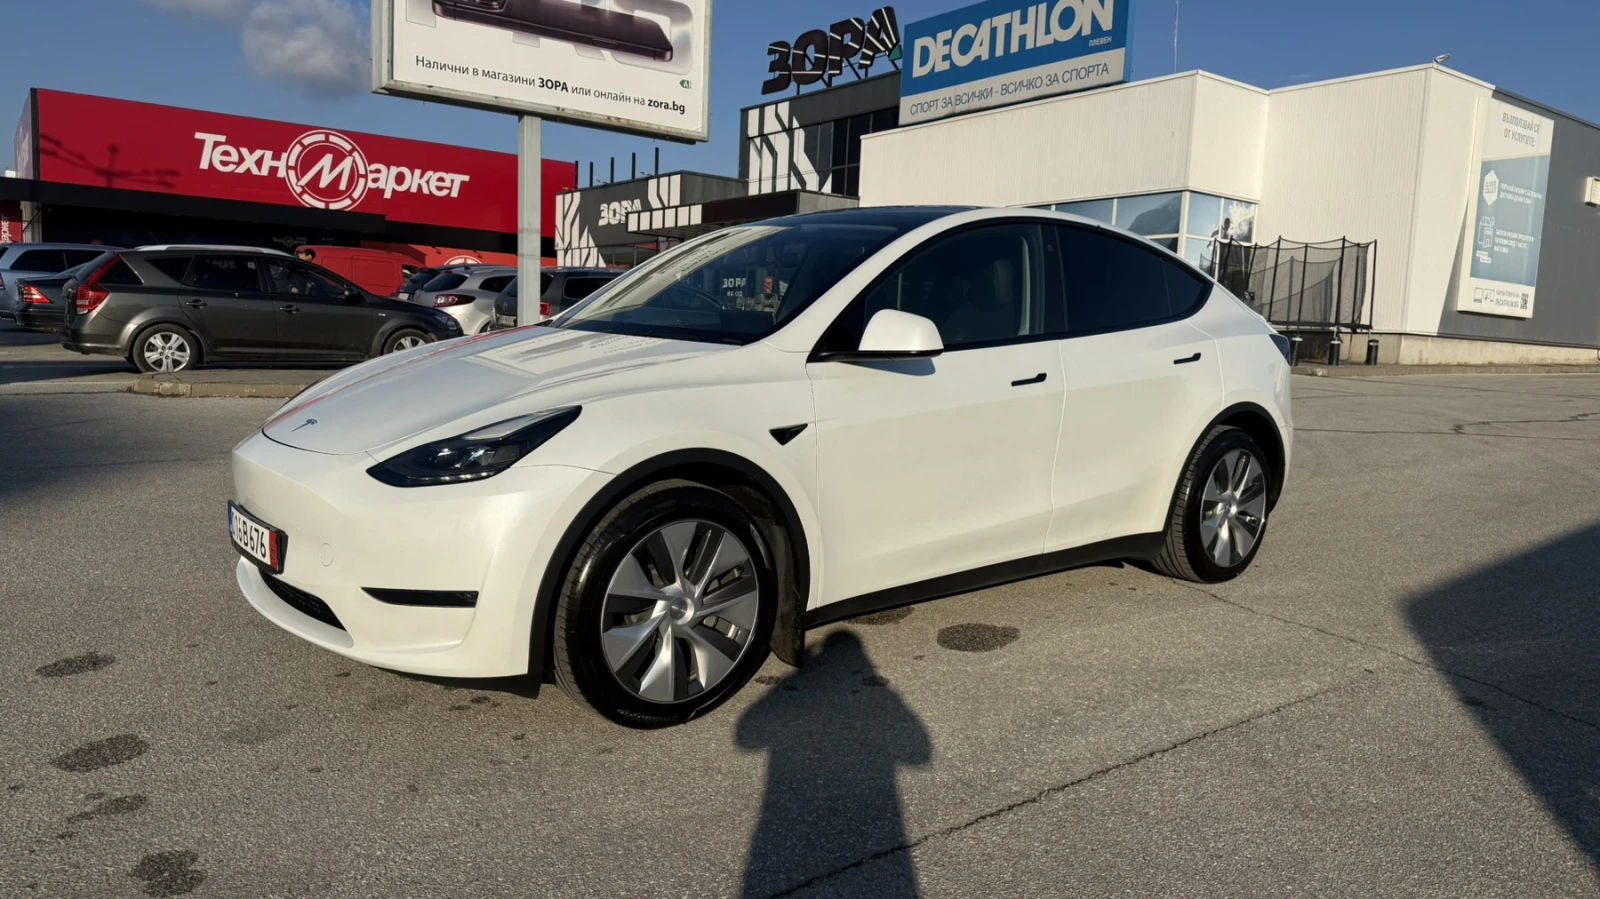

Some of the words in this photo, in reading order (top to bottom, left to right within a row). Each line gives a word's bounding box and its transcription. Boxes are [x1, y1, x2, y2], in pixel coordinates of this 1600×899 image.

[761, 6, 902, 95] ЗОРА
[912, 0, 1114, 78] DECATHLON
[1088, 36, 1112, 47] ПЛЕВЕН
[415, 55, 469, 75] Налични
[472, 67, 479, 76] в
[481, 69, 536, 87] магазини
[537, 77, 569, 93] ЗОРА
[571, 85, 591, 97] или
[593, 90, 631, 104] онлайн
[633, 97, 646, 106] на
[647, 99, 686, 115] zora.bg
[910, 98, 940, 116] СПОРТ
[941, 96, 953, 109] ЗА
[954, 86, 993, 107] ВСИЧКИ
[1000, 76, 1043, 96] ВСИЧКО
[1045, 73, 1060, 87] ЗА
[1061, 62, 1110, 84] СПОРТА
